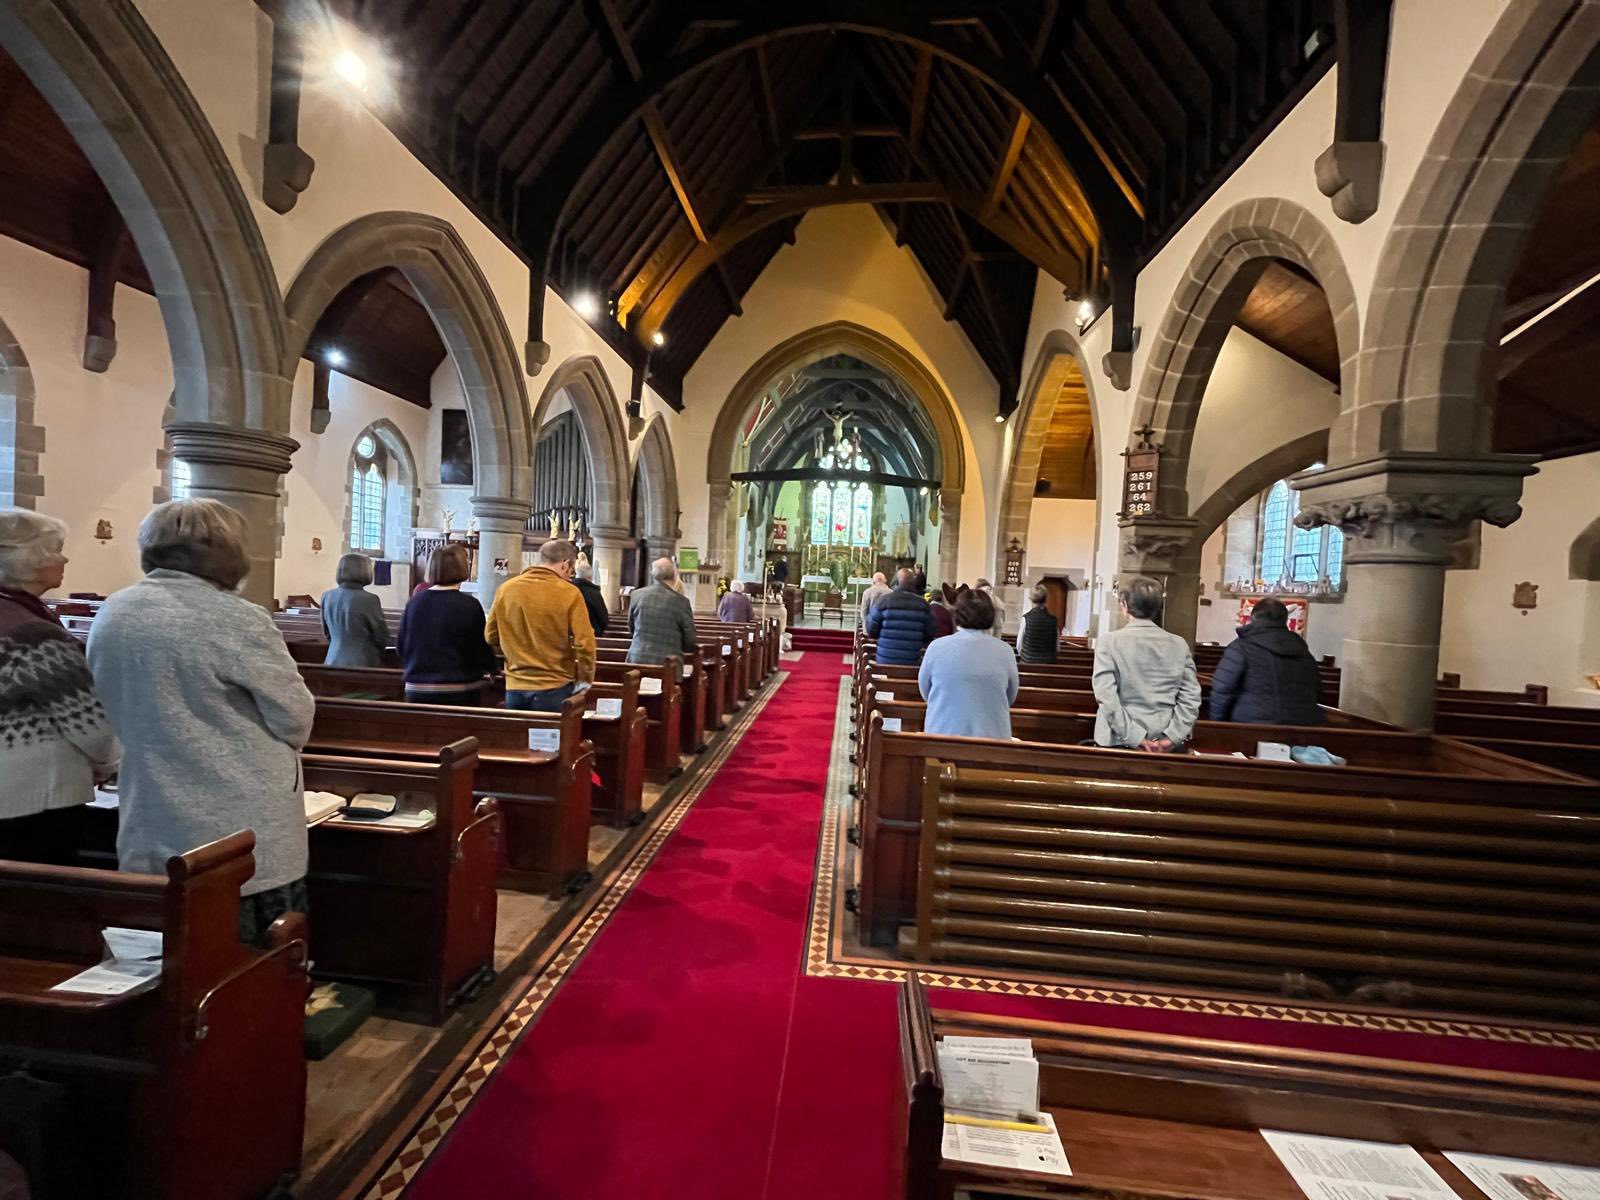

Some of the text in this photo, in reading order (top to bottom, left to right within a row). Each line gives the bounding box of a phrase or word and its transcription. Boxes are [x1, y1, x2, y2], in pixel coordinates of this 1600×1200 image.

[1131, 472, 1153, 481] 259
[1130, 482, 1151, 491] 261
[1133, 493, 1147, 501] 64
[1129, 503, 1151, 511] 262
